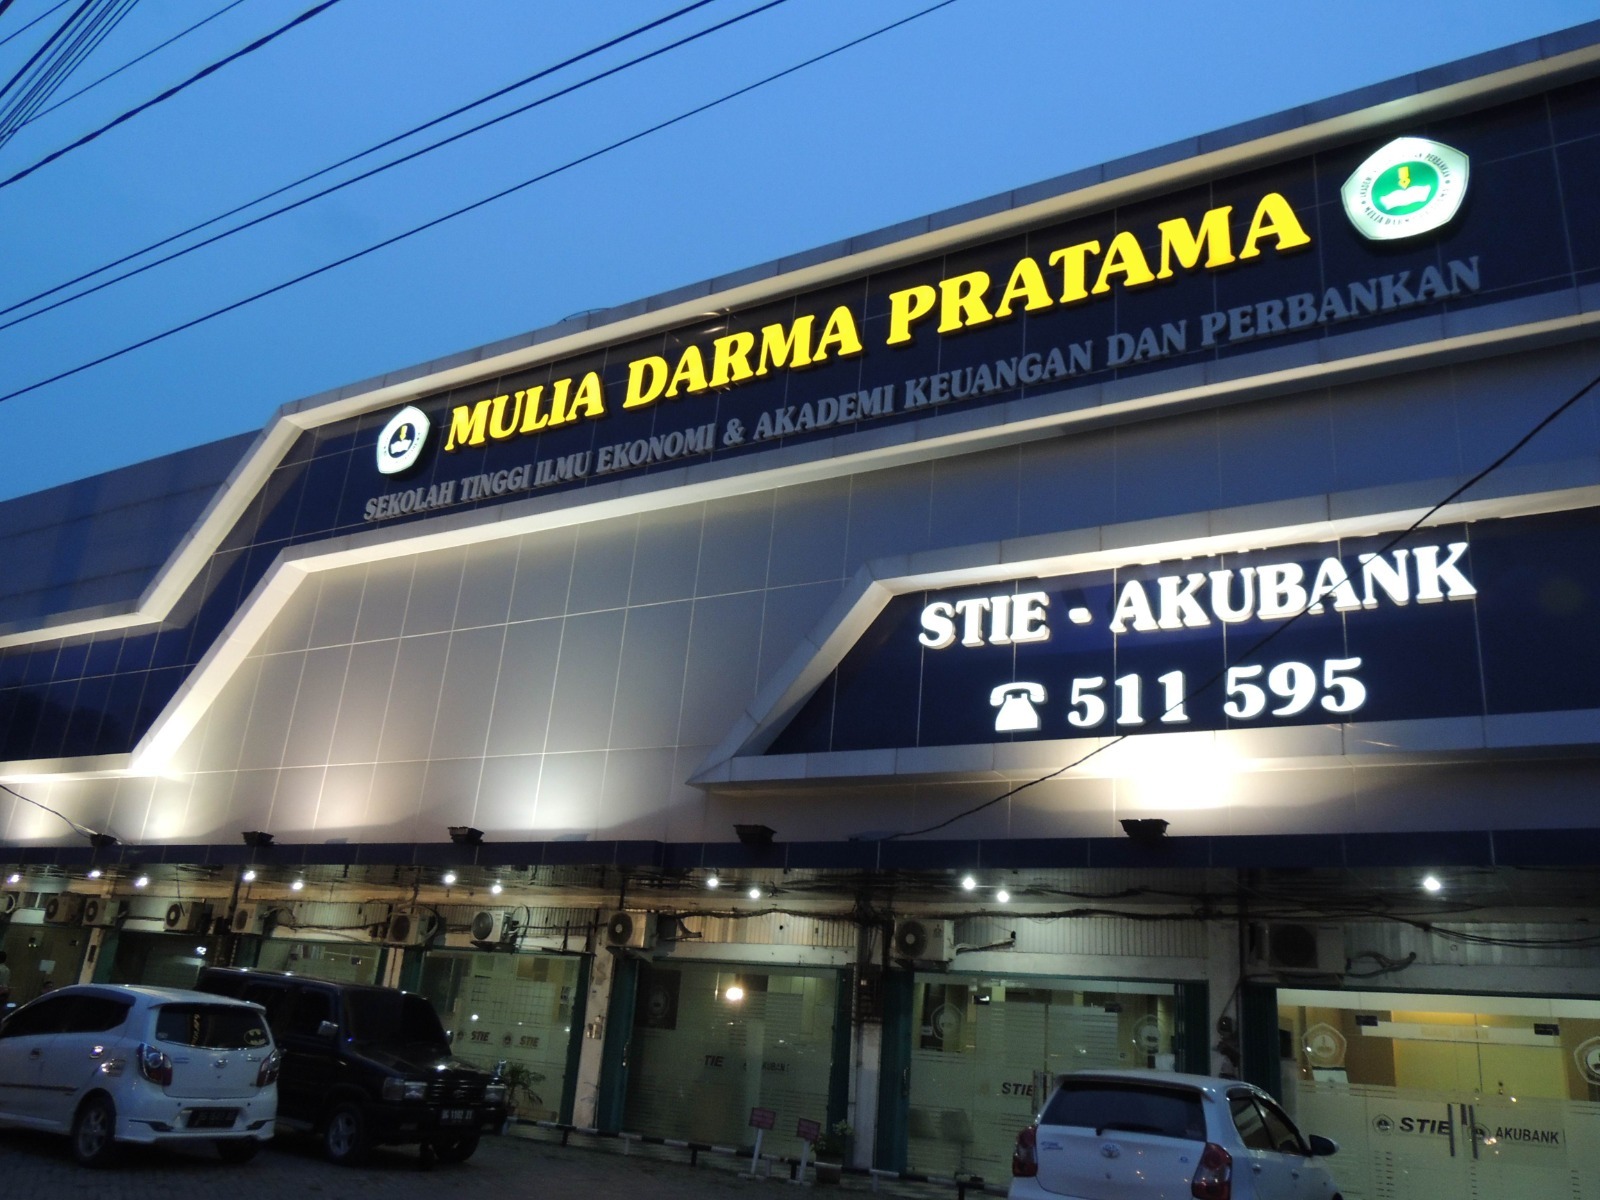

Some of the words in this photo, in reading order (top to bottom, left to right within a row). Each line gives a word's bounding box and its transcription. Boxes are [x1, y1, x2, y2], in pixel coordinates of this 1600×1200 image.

[444, 371, 605, 452] MULIA
[623, 305, 863, 409] DARMA
[886, 192, 1311, 345] PRATAMA
[364, 479, 458, 521] SEKOLAH
[460, 463, 533, 501] TINGGI
[534, 450, 593, 486] ILMU
[596, 422, 718, 473] EKONOMI
[722, 417, 746, 446] &
[753, 384, 896, 440] AKADEMI
[904, 340, 1092, 409] KEUANGAN
[1107, 319, 1187, 366] DAN
[1201, 256, 1480, 347] PERBANKAN
[918, 591, 1050, 649] STIE
[1110, 542, 1477, 634] AKUBANK
[1067, 670, 1190, 727] 511
[1223, 657, 1367, 718] 595
[471, 1030, 490, 1042] STIE
[519, 1035, 539, 1047] STIE
[1001, 1082, 1033, 1096] STIE
[1399, 1117, 1451, 1135] STIE
[1495, 1126, 1560, 1145] AKUBANK
